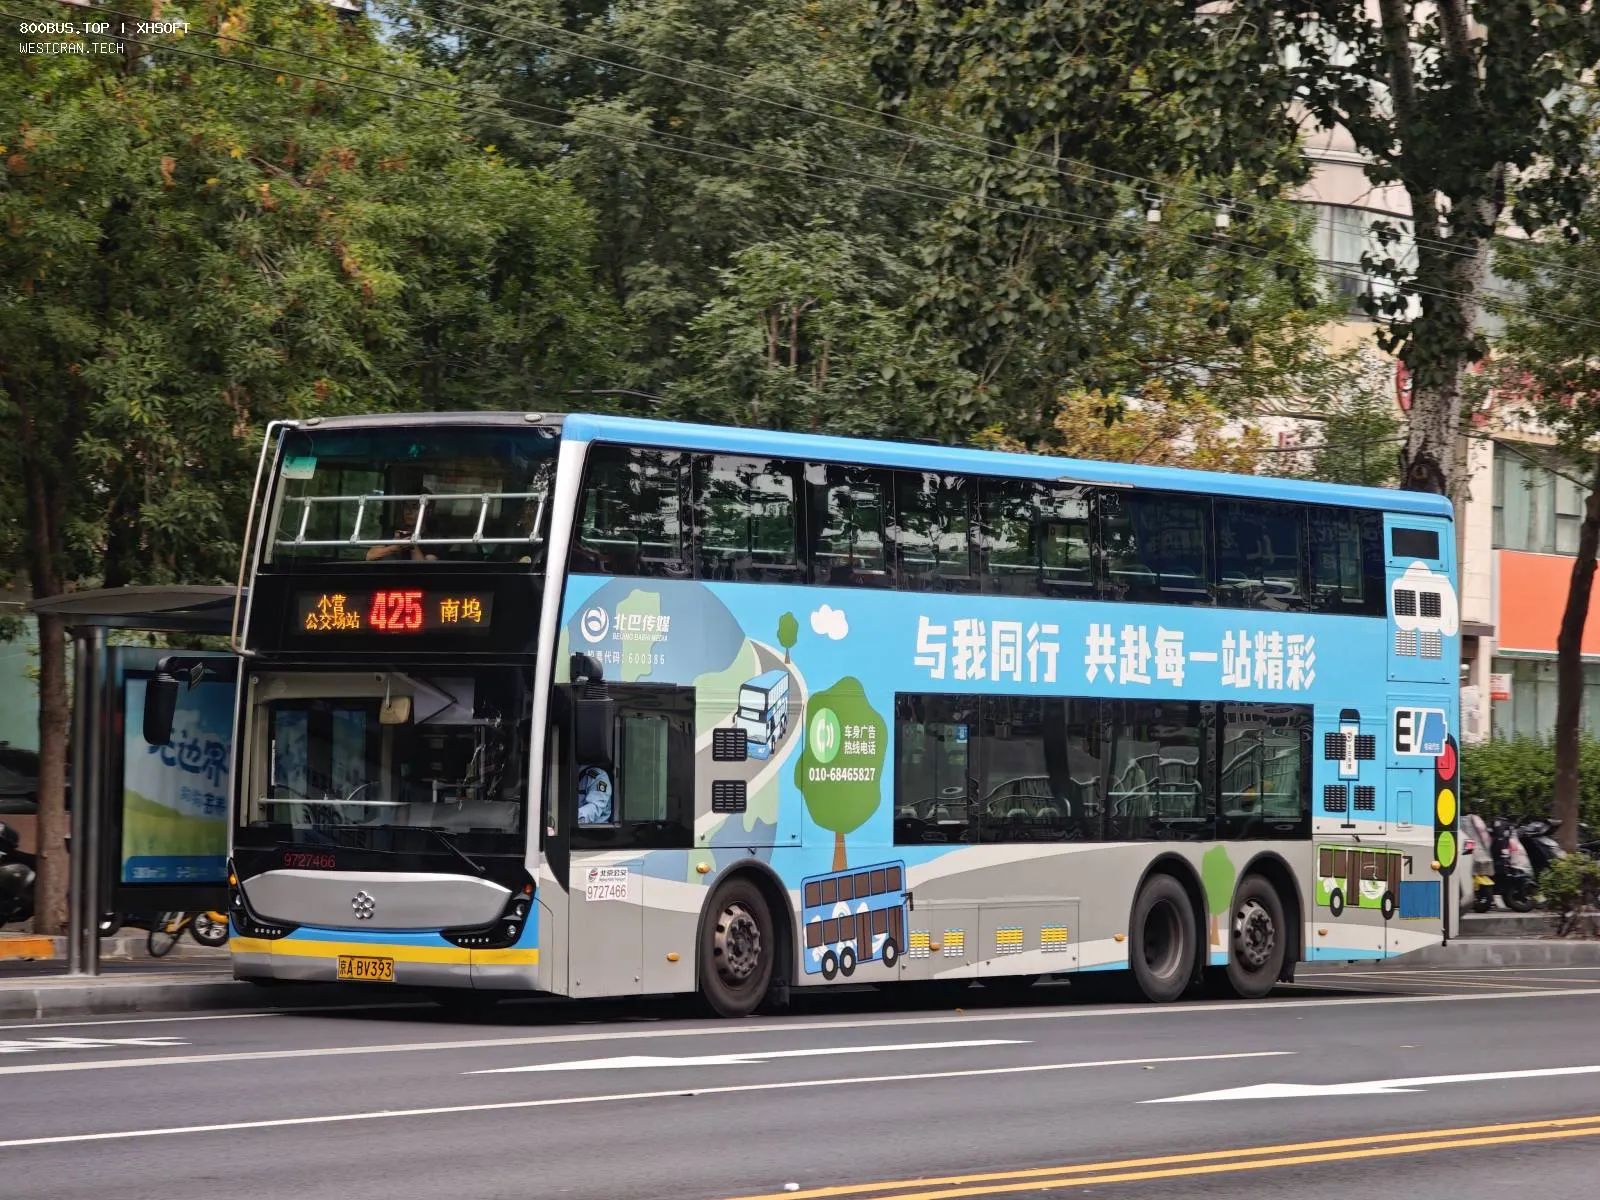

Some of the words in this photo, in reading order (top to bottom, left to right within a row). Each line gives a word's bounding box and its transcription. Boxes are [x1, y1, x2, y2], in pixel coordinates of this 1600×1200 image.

[317, 594, 347, 613] 小营
[370, 592, 422, 629] 425
[440, 598, 482, 623] 南坞
[305, 610, 361, 630] 公交场站
[612, 613, 670, 632] 北巴传媒
[914, 615, 1060, 683] 与我同行
[1084, 623, 1316, 690] 共赴每一站精彩
[844, 724, 876, 739] 车身广告
[844, 741, 876, 755] 热线电话
[808, 767, 876, 782] 010-68465827
[284, 853, 336, 868] 9727466
[587, 884, 627, 899] 9727466
